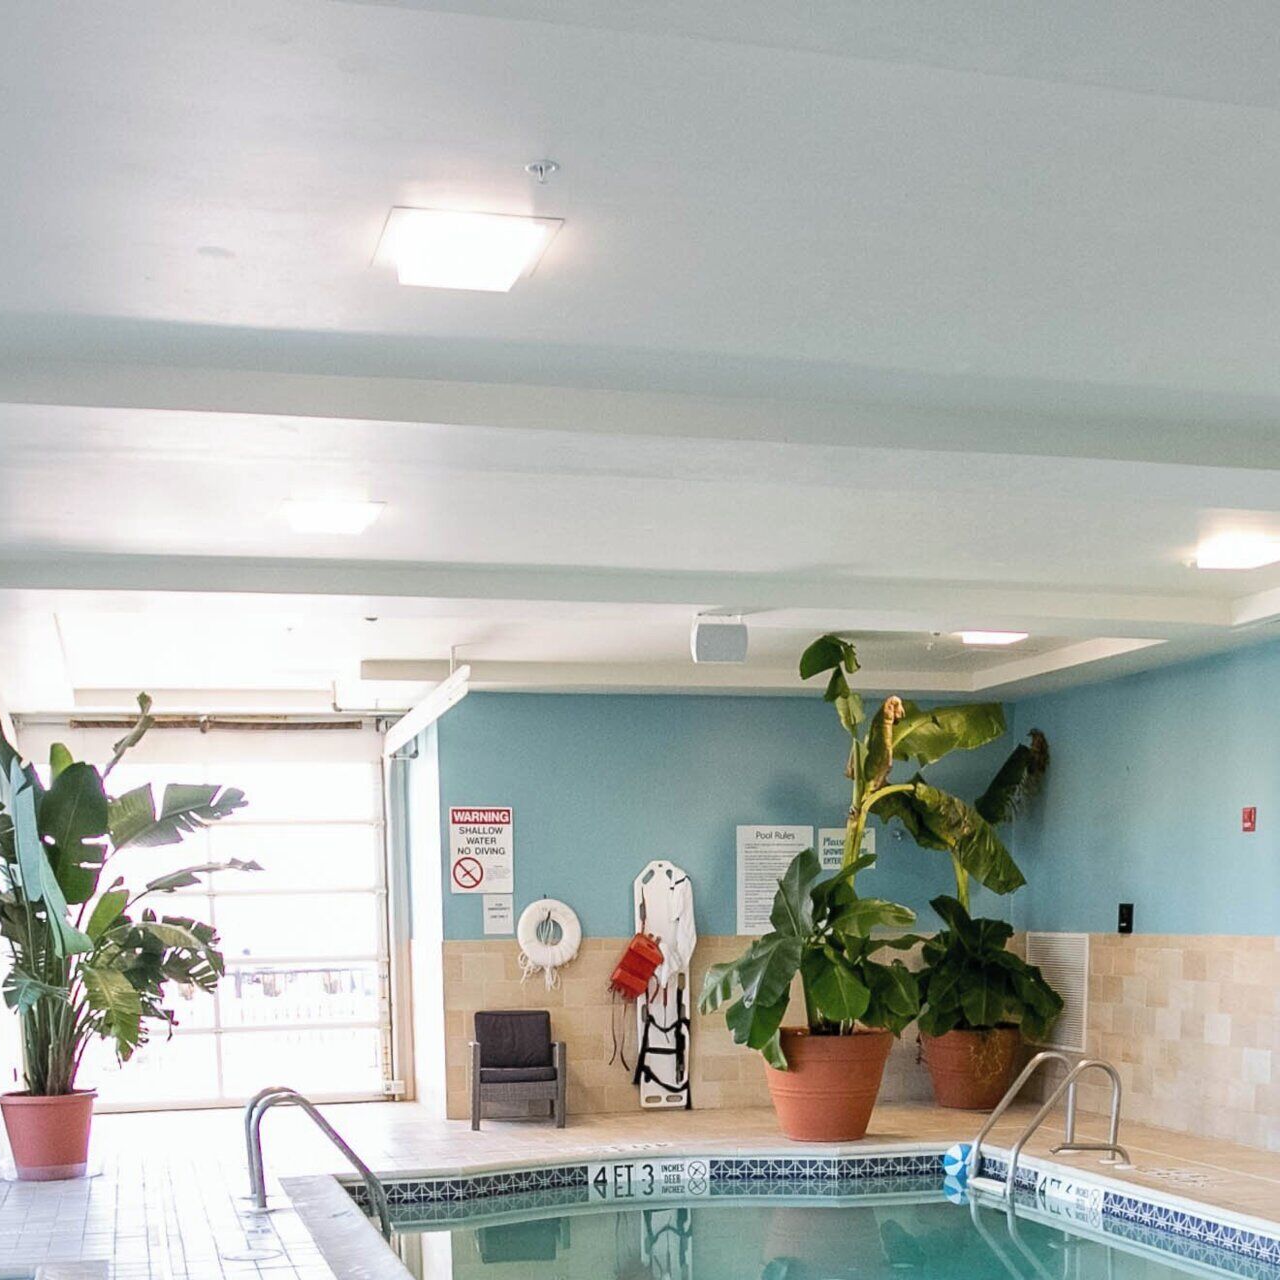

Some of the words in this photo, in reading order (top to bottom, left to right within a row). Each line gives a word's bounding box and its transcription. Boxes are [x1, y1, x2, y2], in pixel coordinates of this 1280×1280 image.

[453, 811, 509, 823] WARNING
[459, 827, 503, 835] SHALLOW
[756, 831, 772, 839] Pool
[775, 831, 795, 840] Rules
[466, 837, 497, 845] WATER
[458, 847, 471, 855] NO
[474, 847, 506, 855] DIVING
[594, 1166, 607, 1183] 4
[661, 1164, 684, 1172] INCHES
